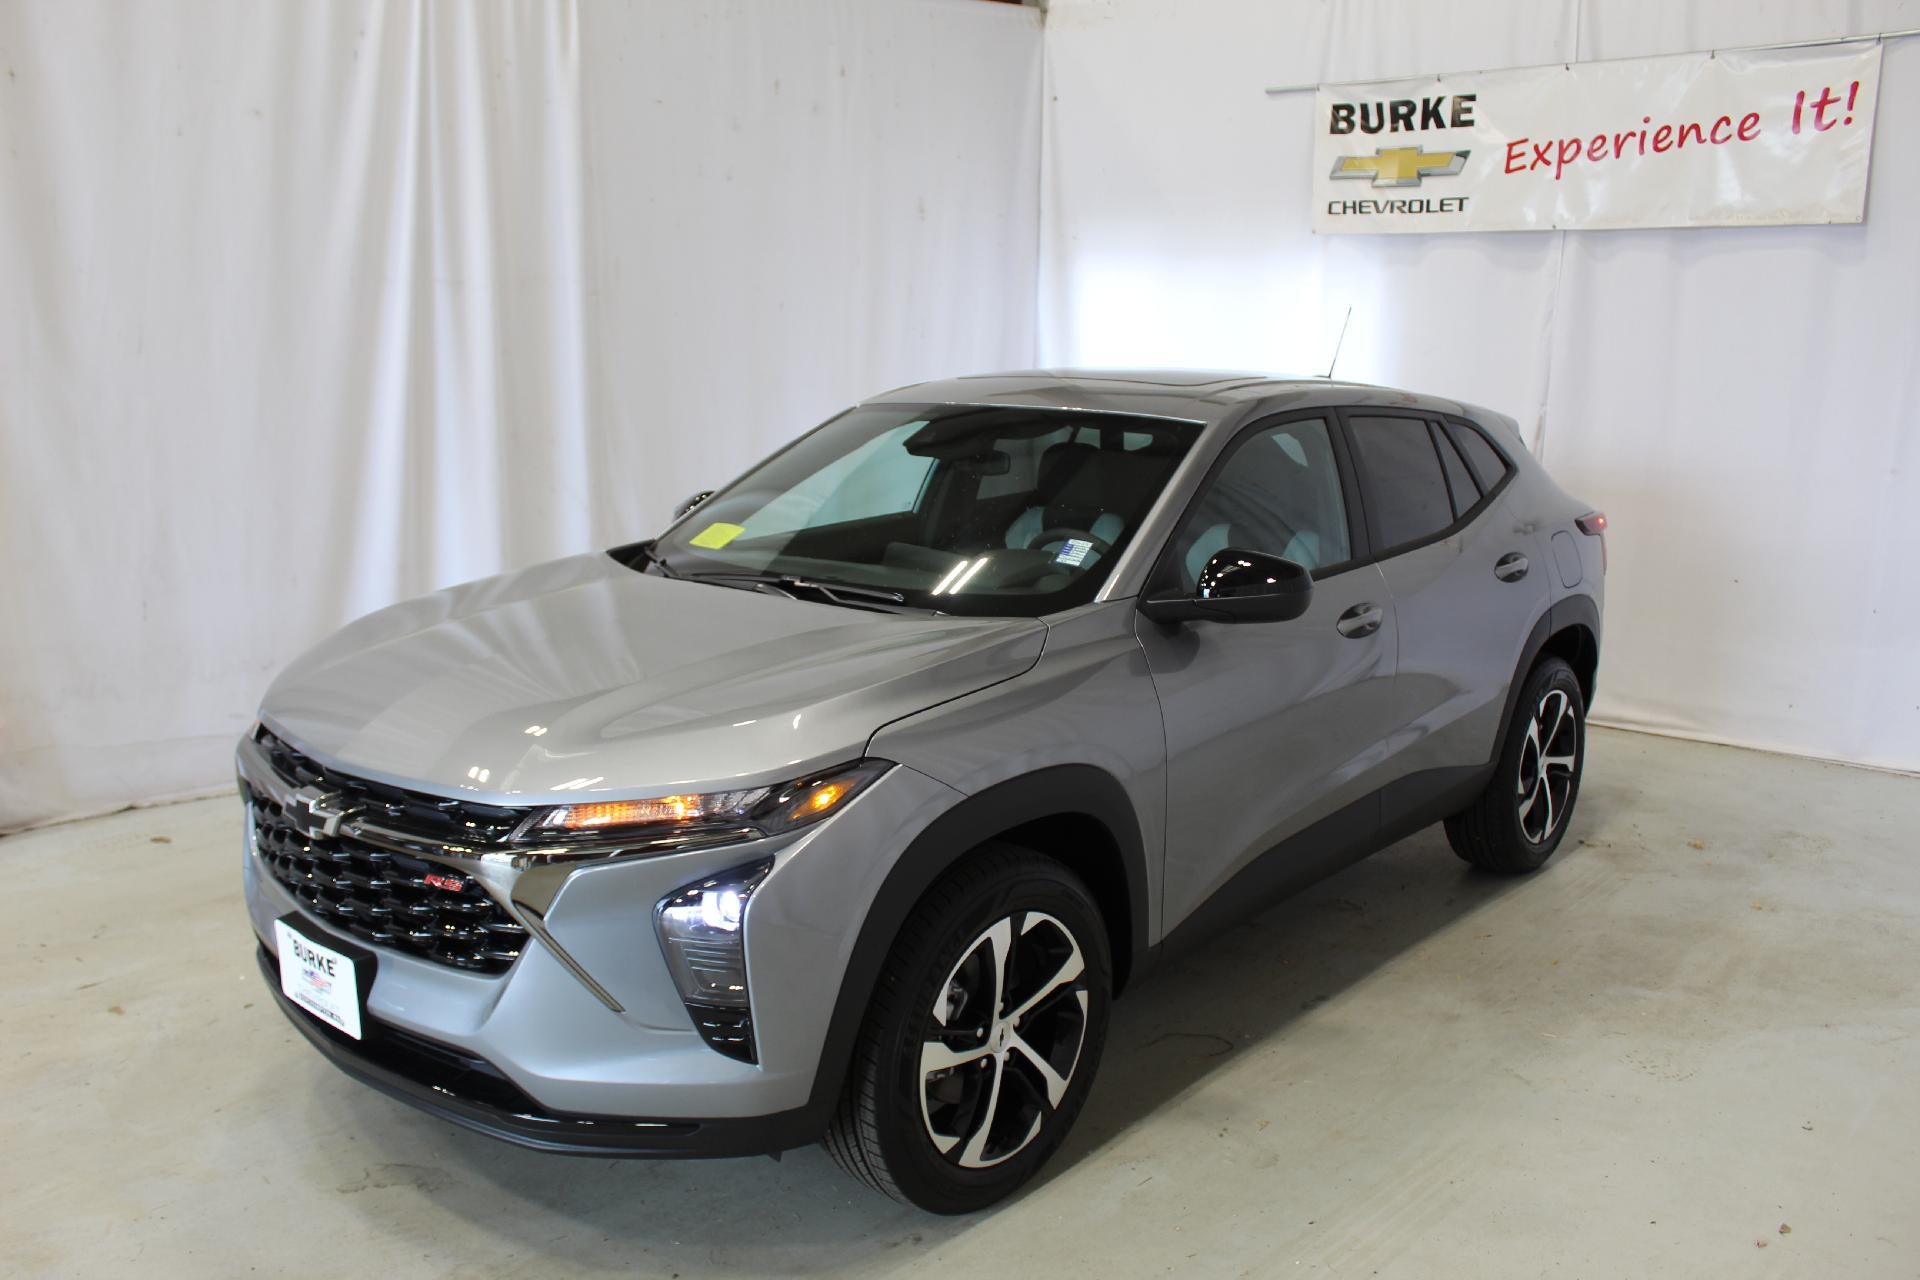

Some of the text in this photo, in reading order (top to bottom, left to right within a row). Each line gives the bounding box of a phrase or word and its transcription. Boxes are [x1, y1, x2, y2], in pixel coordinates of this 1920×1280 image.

[1330, 94, 1476, 134] BURKE
[1504, 80, 1860, 180] Experience It!
[1328, 197, 1469, 215] CHEVROLET
[424, 874, 462, 892] RS
[293, 939, 335, 977] BURKE
